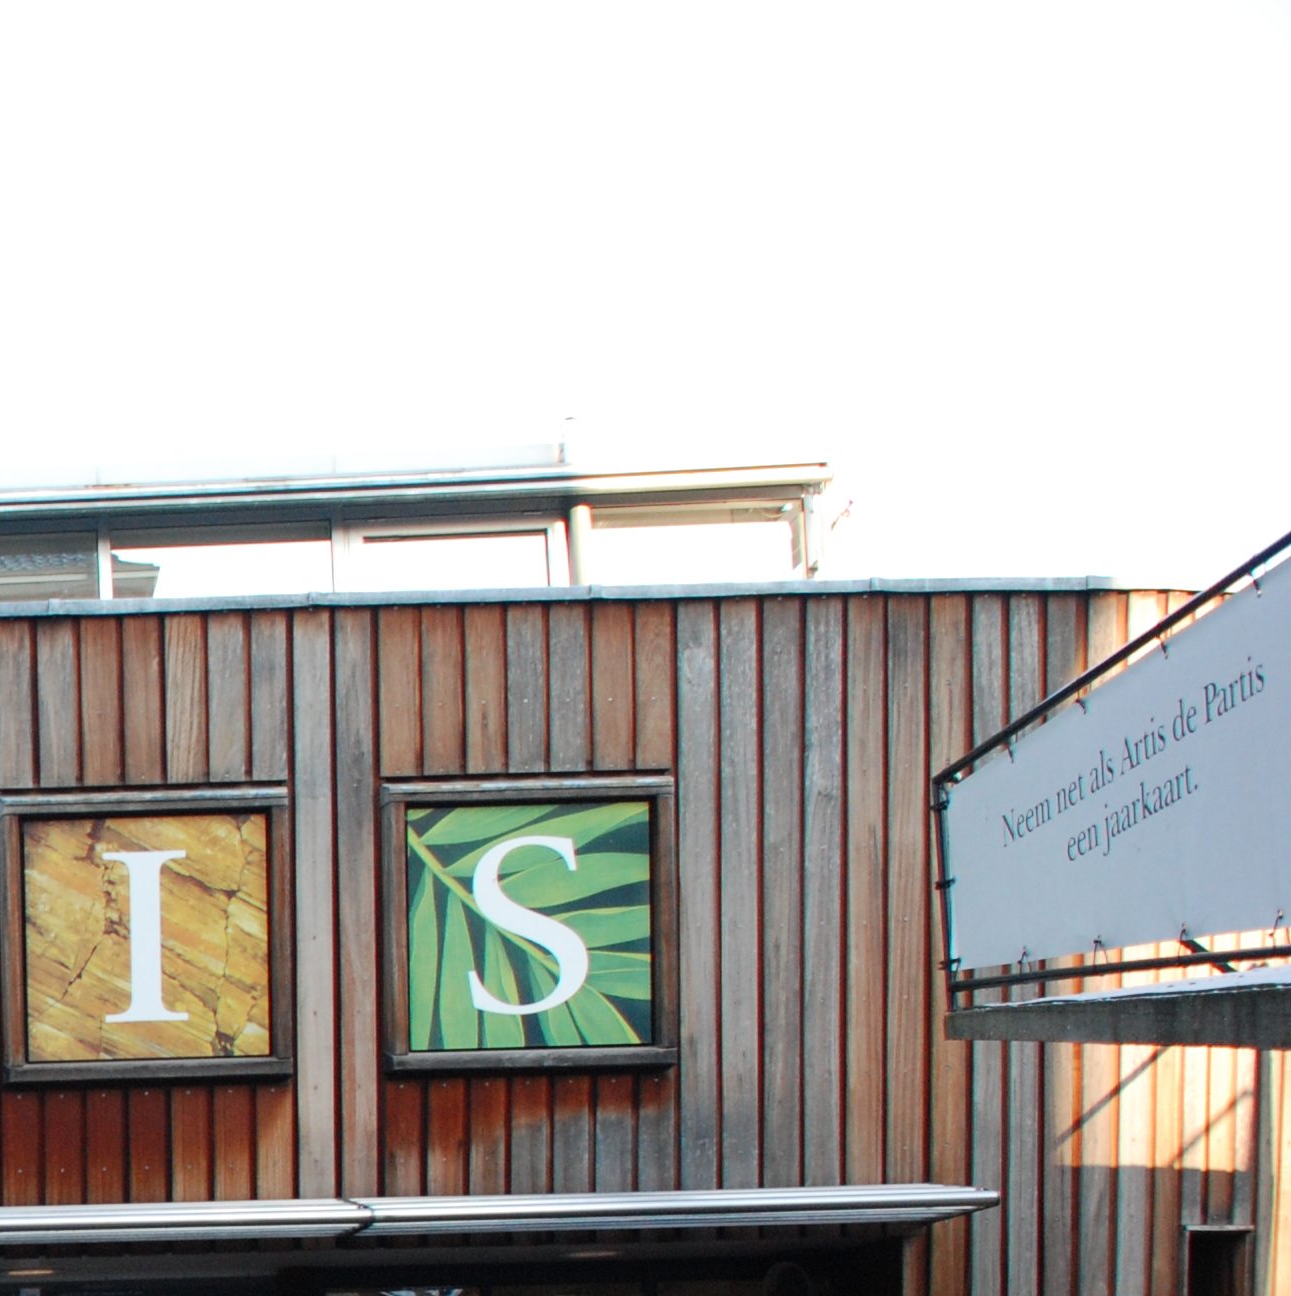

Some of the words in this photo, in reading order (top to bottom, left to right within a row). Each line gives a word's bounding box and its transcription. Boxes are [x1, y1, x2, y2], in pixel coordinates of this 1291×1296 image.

[1002, 797, 1052, 848] Neem
[1056, 773, 1086, 815] net
[1089, 750, 1115, 794] als
[1119, 716, 1167, 776] Artis
[1172, 698, 1198, 742] de
[1202, 655, 1266, 724] Partis
[1066, 822, 1100, 862] een
[1102, 765, 1199, 857] jaarkaart.
